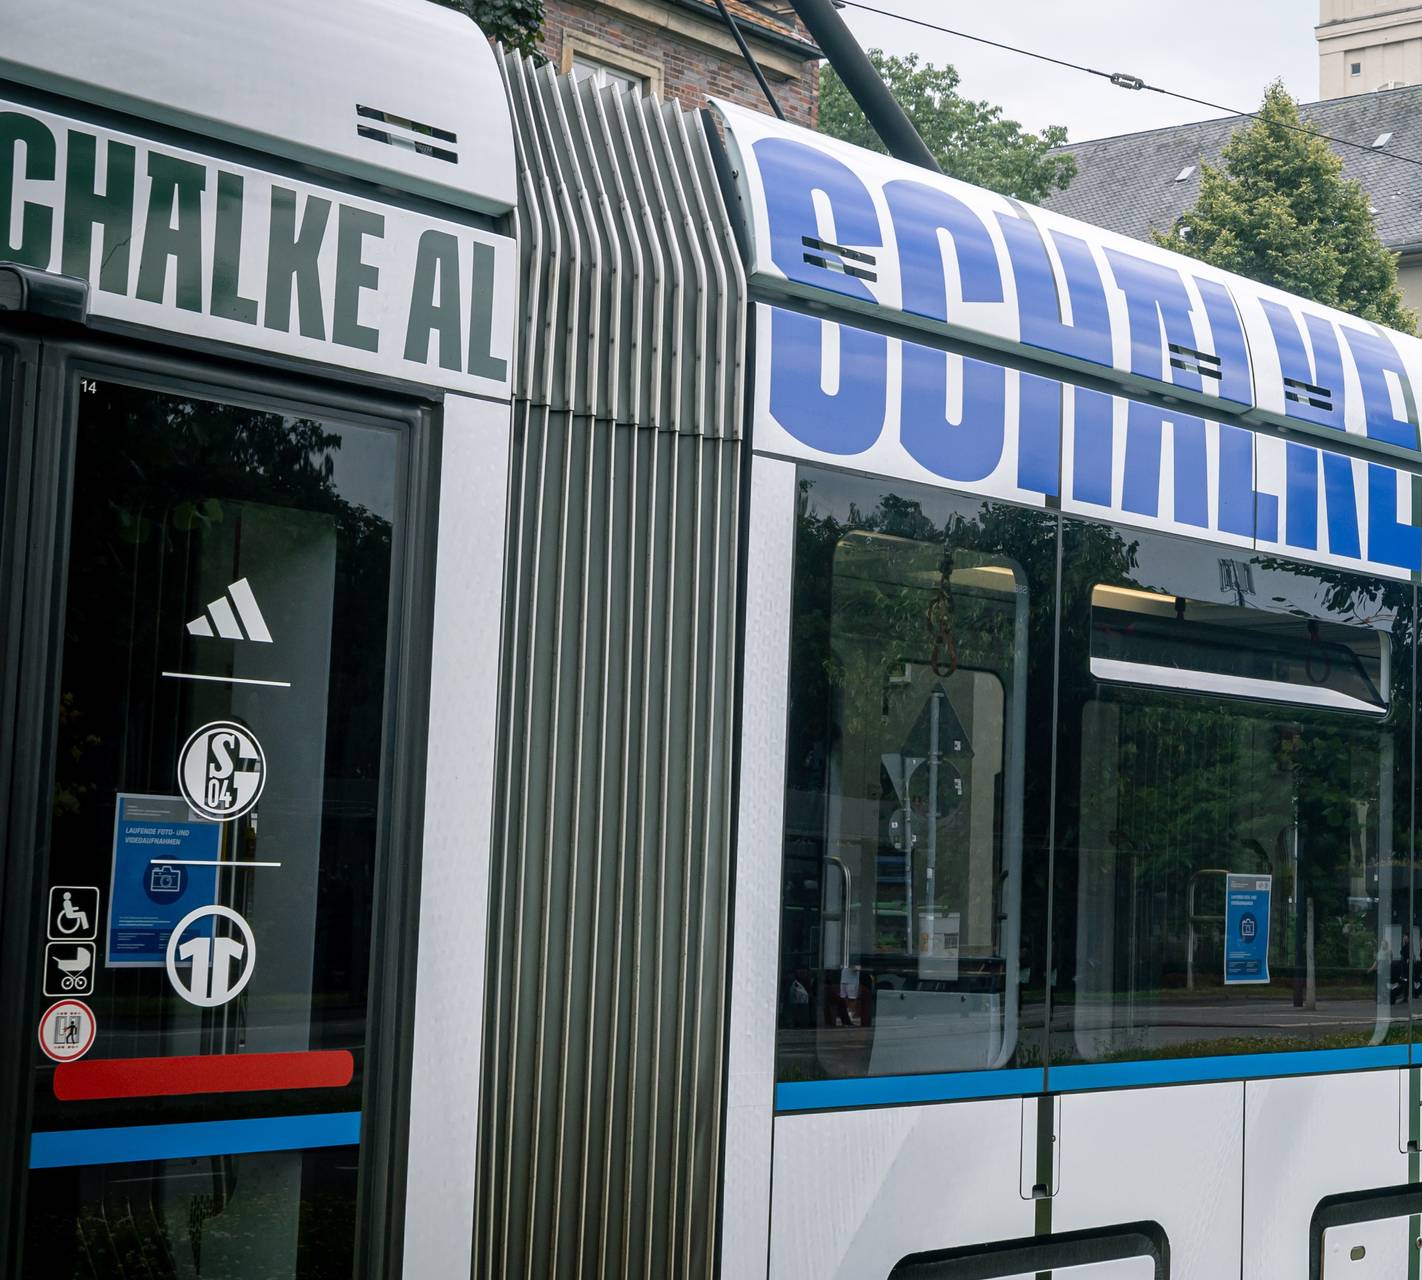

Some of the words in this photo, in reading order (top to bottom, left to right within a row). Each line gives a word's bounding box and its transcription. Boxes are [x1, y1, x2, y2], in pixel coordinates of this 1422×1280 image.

[403, 229, 508, 383] AL
[752, 137, 1422, 572] SCHALKE
[80, 379, 97, 394] 14
